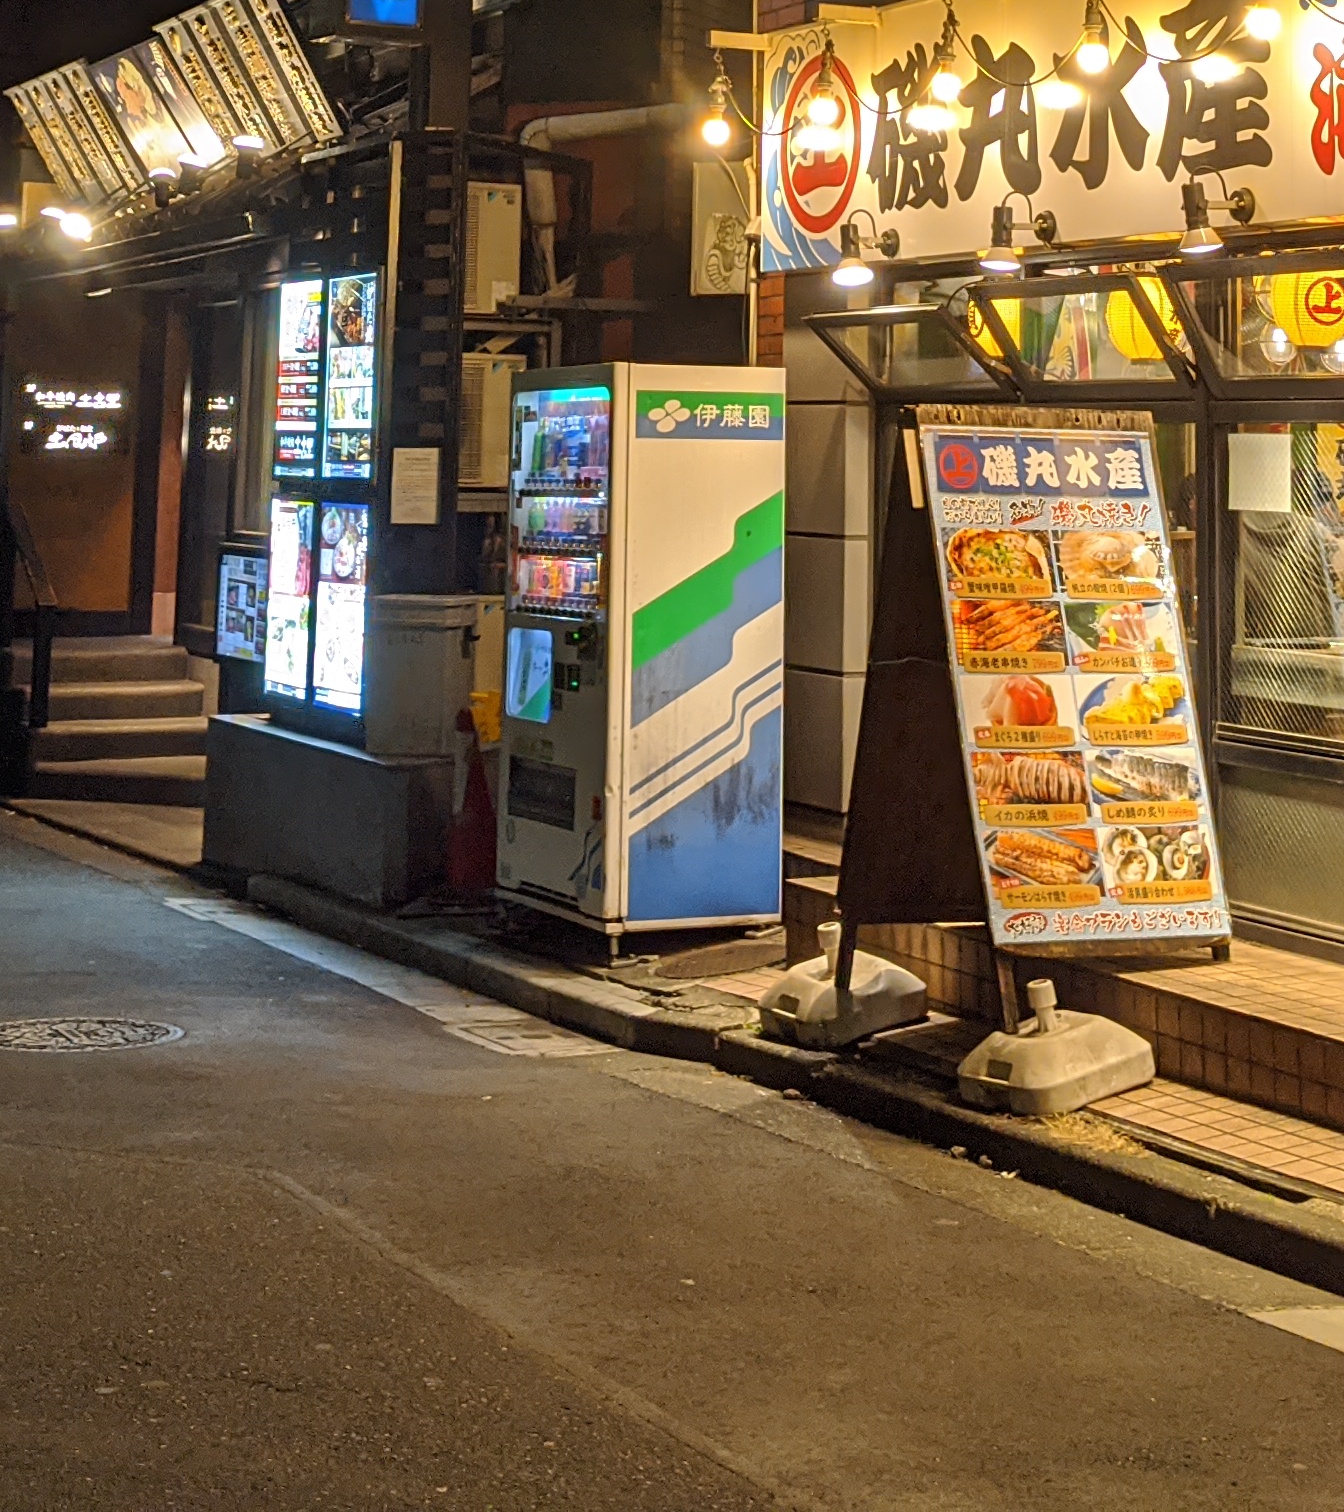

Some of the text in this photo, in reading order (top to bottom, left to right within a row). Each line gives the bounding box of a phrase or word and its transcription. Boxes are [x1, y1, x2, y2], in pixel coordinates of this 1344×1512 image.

[694, 402, 770, 429] 伊藤園
[980, 444, 1145, 490] 磯丸水産
[995, 810, 1050, 822] イカの浜焼
